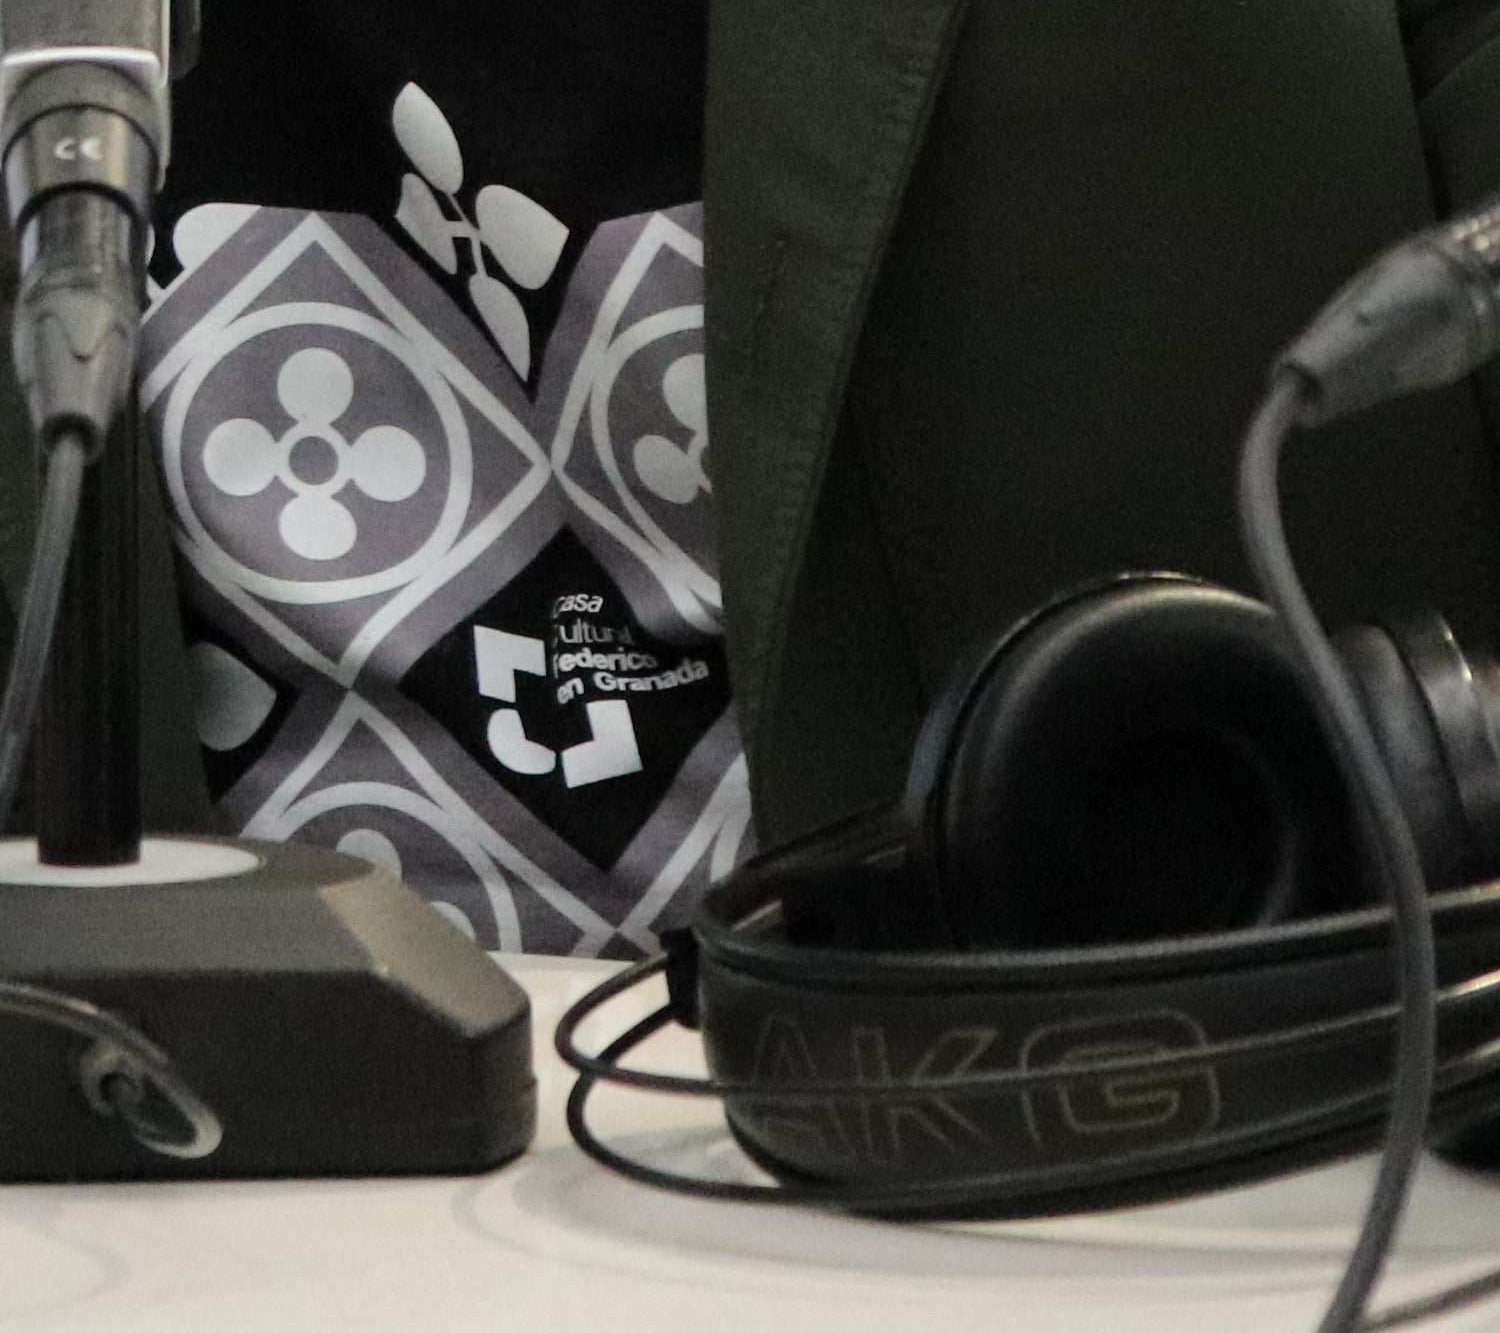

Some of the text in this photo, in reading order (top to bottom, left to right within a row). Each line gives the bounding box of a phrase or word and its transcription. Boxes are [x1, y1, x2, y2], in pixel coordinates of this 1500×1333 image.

[556, 657, 710, 705] en Granada
[748, 1007, 1222, 1165] AKG
